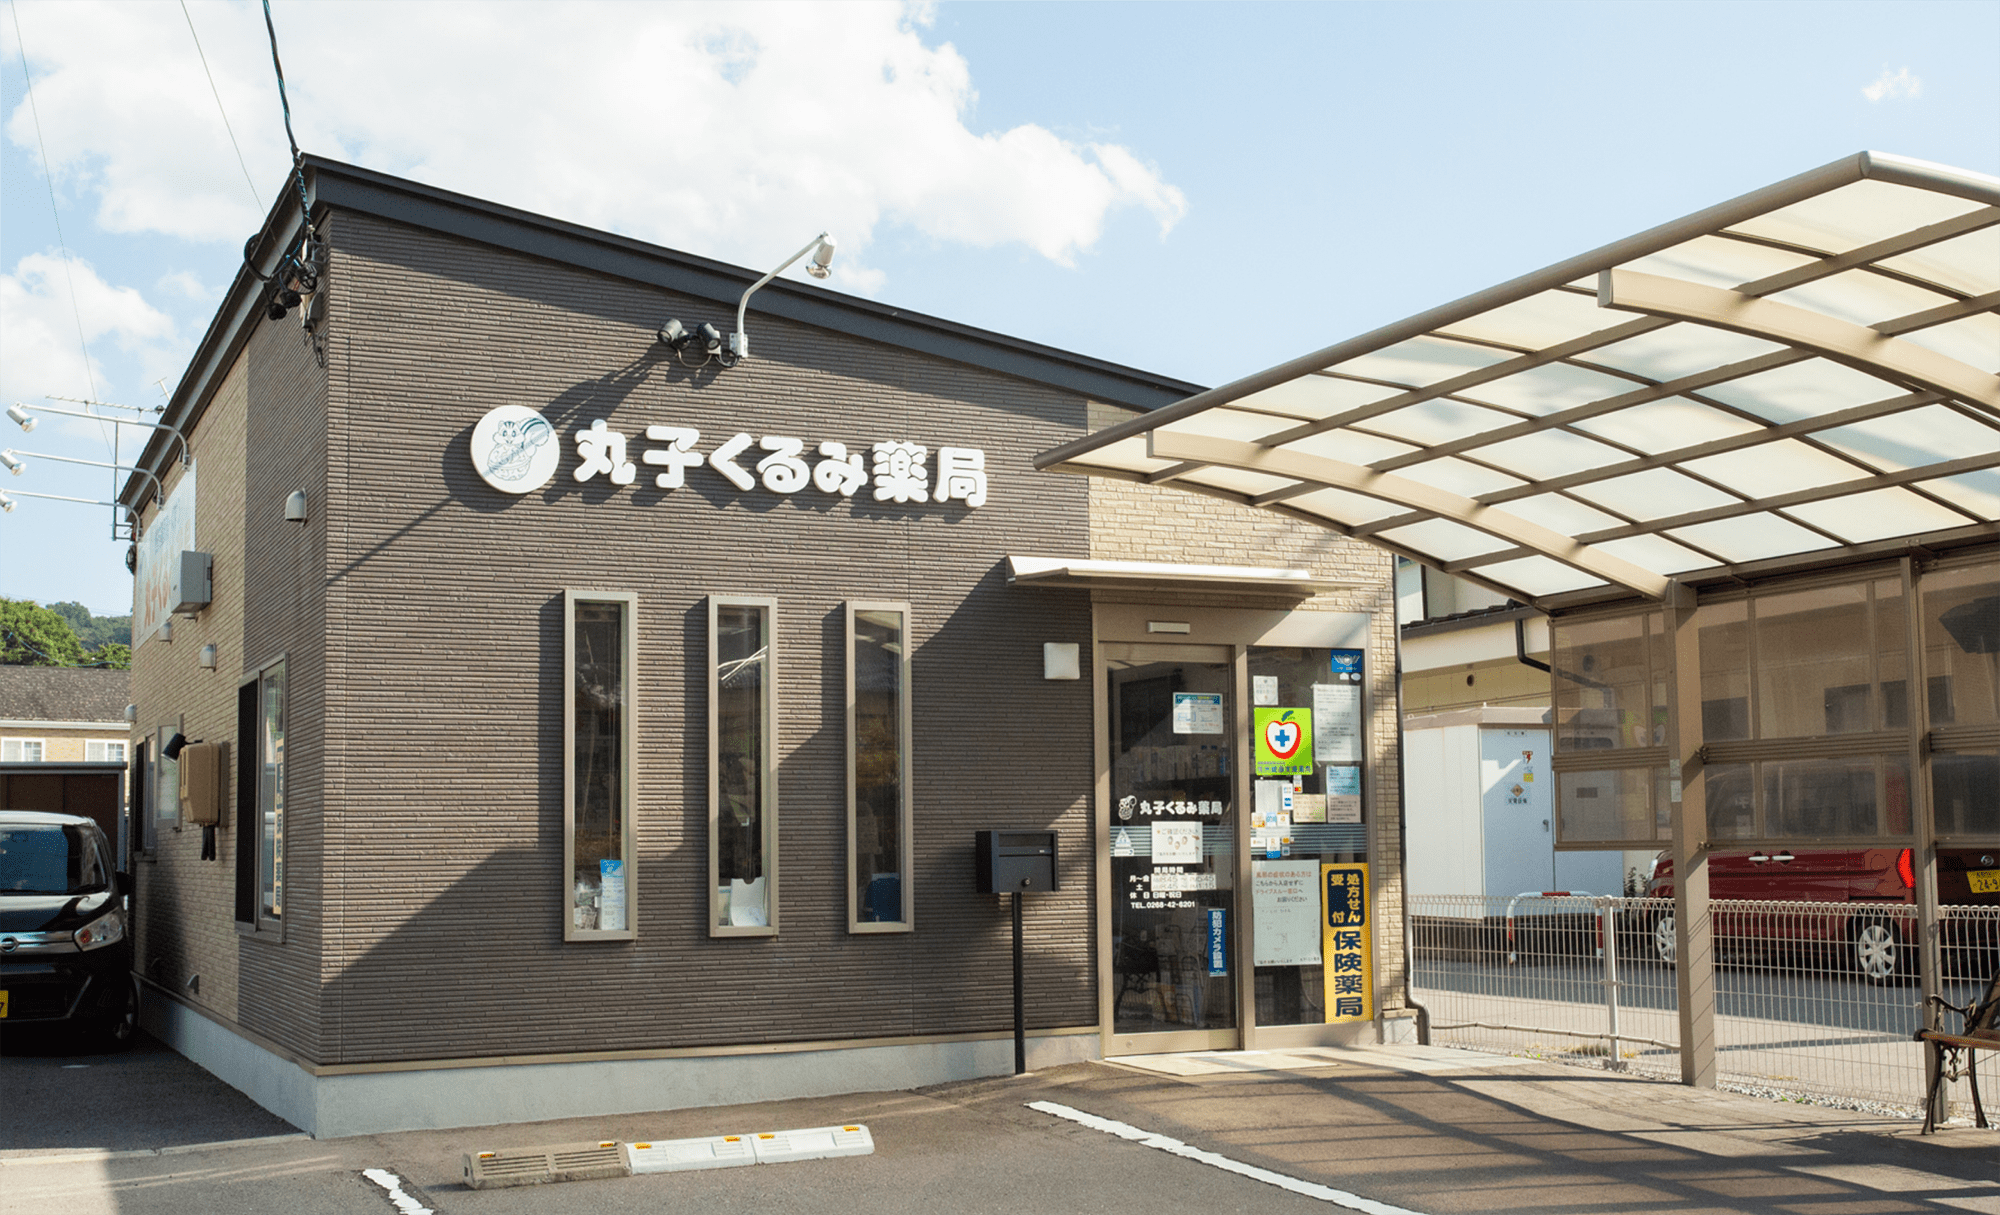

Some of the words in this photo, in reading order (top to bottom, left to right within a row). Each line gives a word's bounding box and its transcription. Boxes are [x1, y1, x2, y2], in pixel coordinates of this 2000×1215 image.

[573, 418, 988, 507] 丸子くるみ薬局
[1140, 800, 1223, 815] 丸子くるみ薬局
[1330, 873, 1345, 924] 受付
[1346, 873, 1361, 923] 処方せん
[1333, 930, 1363, 1017] 保険薬局
